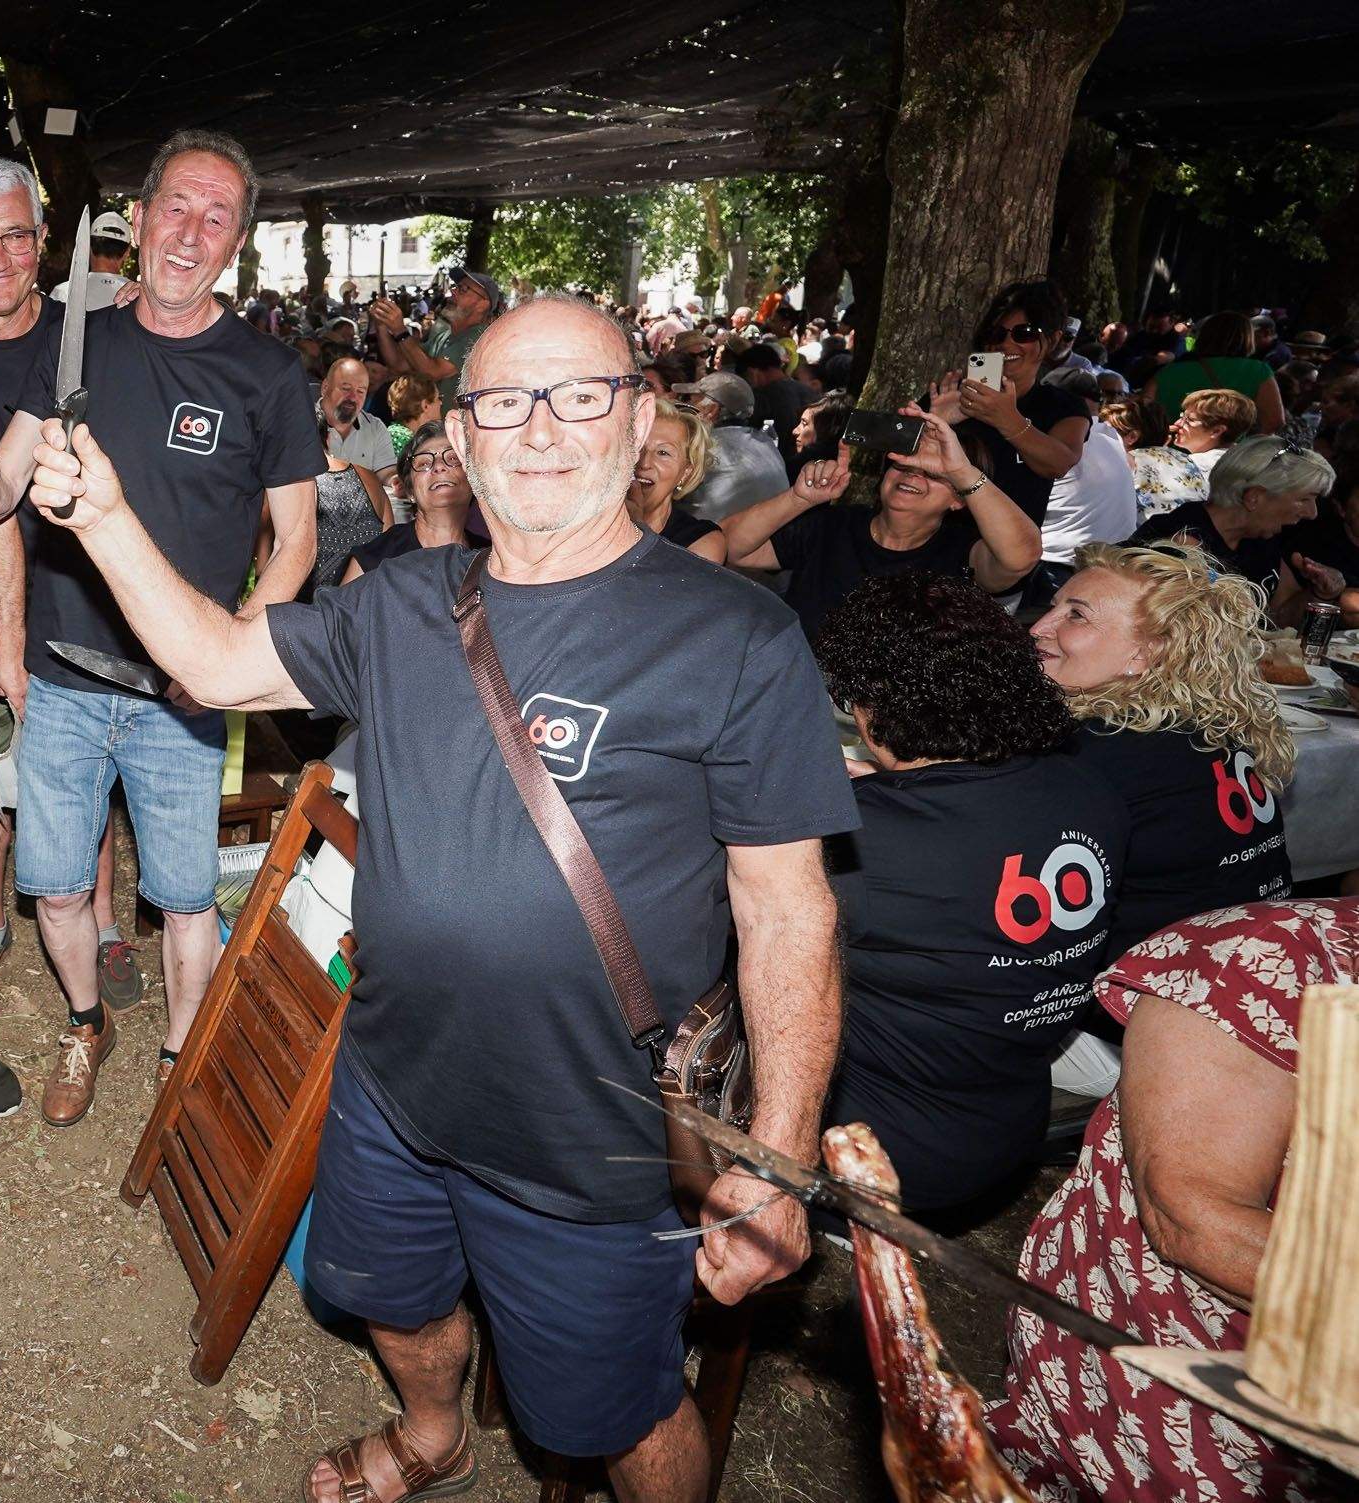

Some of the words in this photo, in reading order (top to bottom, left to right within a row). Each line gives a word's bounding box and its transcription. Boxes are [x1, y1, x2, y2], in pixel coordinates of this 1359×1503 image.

[180, 416, 209, 437] 60
[529, 714, 574, 749] 60
[1061, 830, 1112, 888] ANIVERSARIO
[1219, 852, 1239, 867] AD
[995, 843, 1106, 945] 60
[988, 955, 1012, 968] AD
[1065, 929, 1109, 960] REGUEIR
[1033, 990, 1049, 1003] 60
[1049, 982, 1088, 999] AÑOS
[1023, 1010, 1074, 1032] FUTURO
